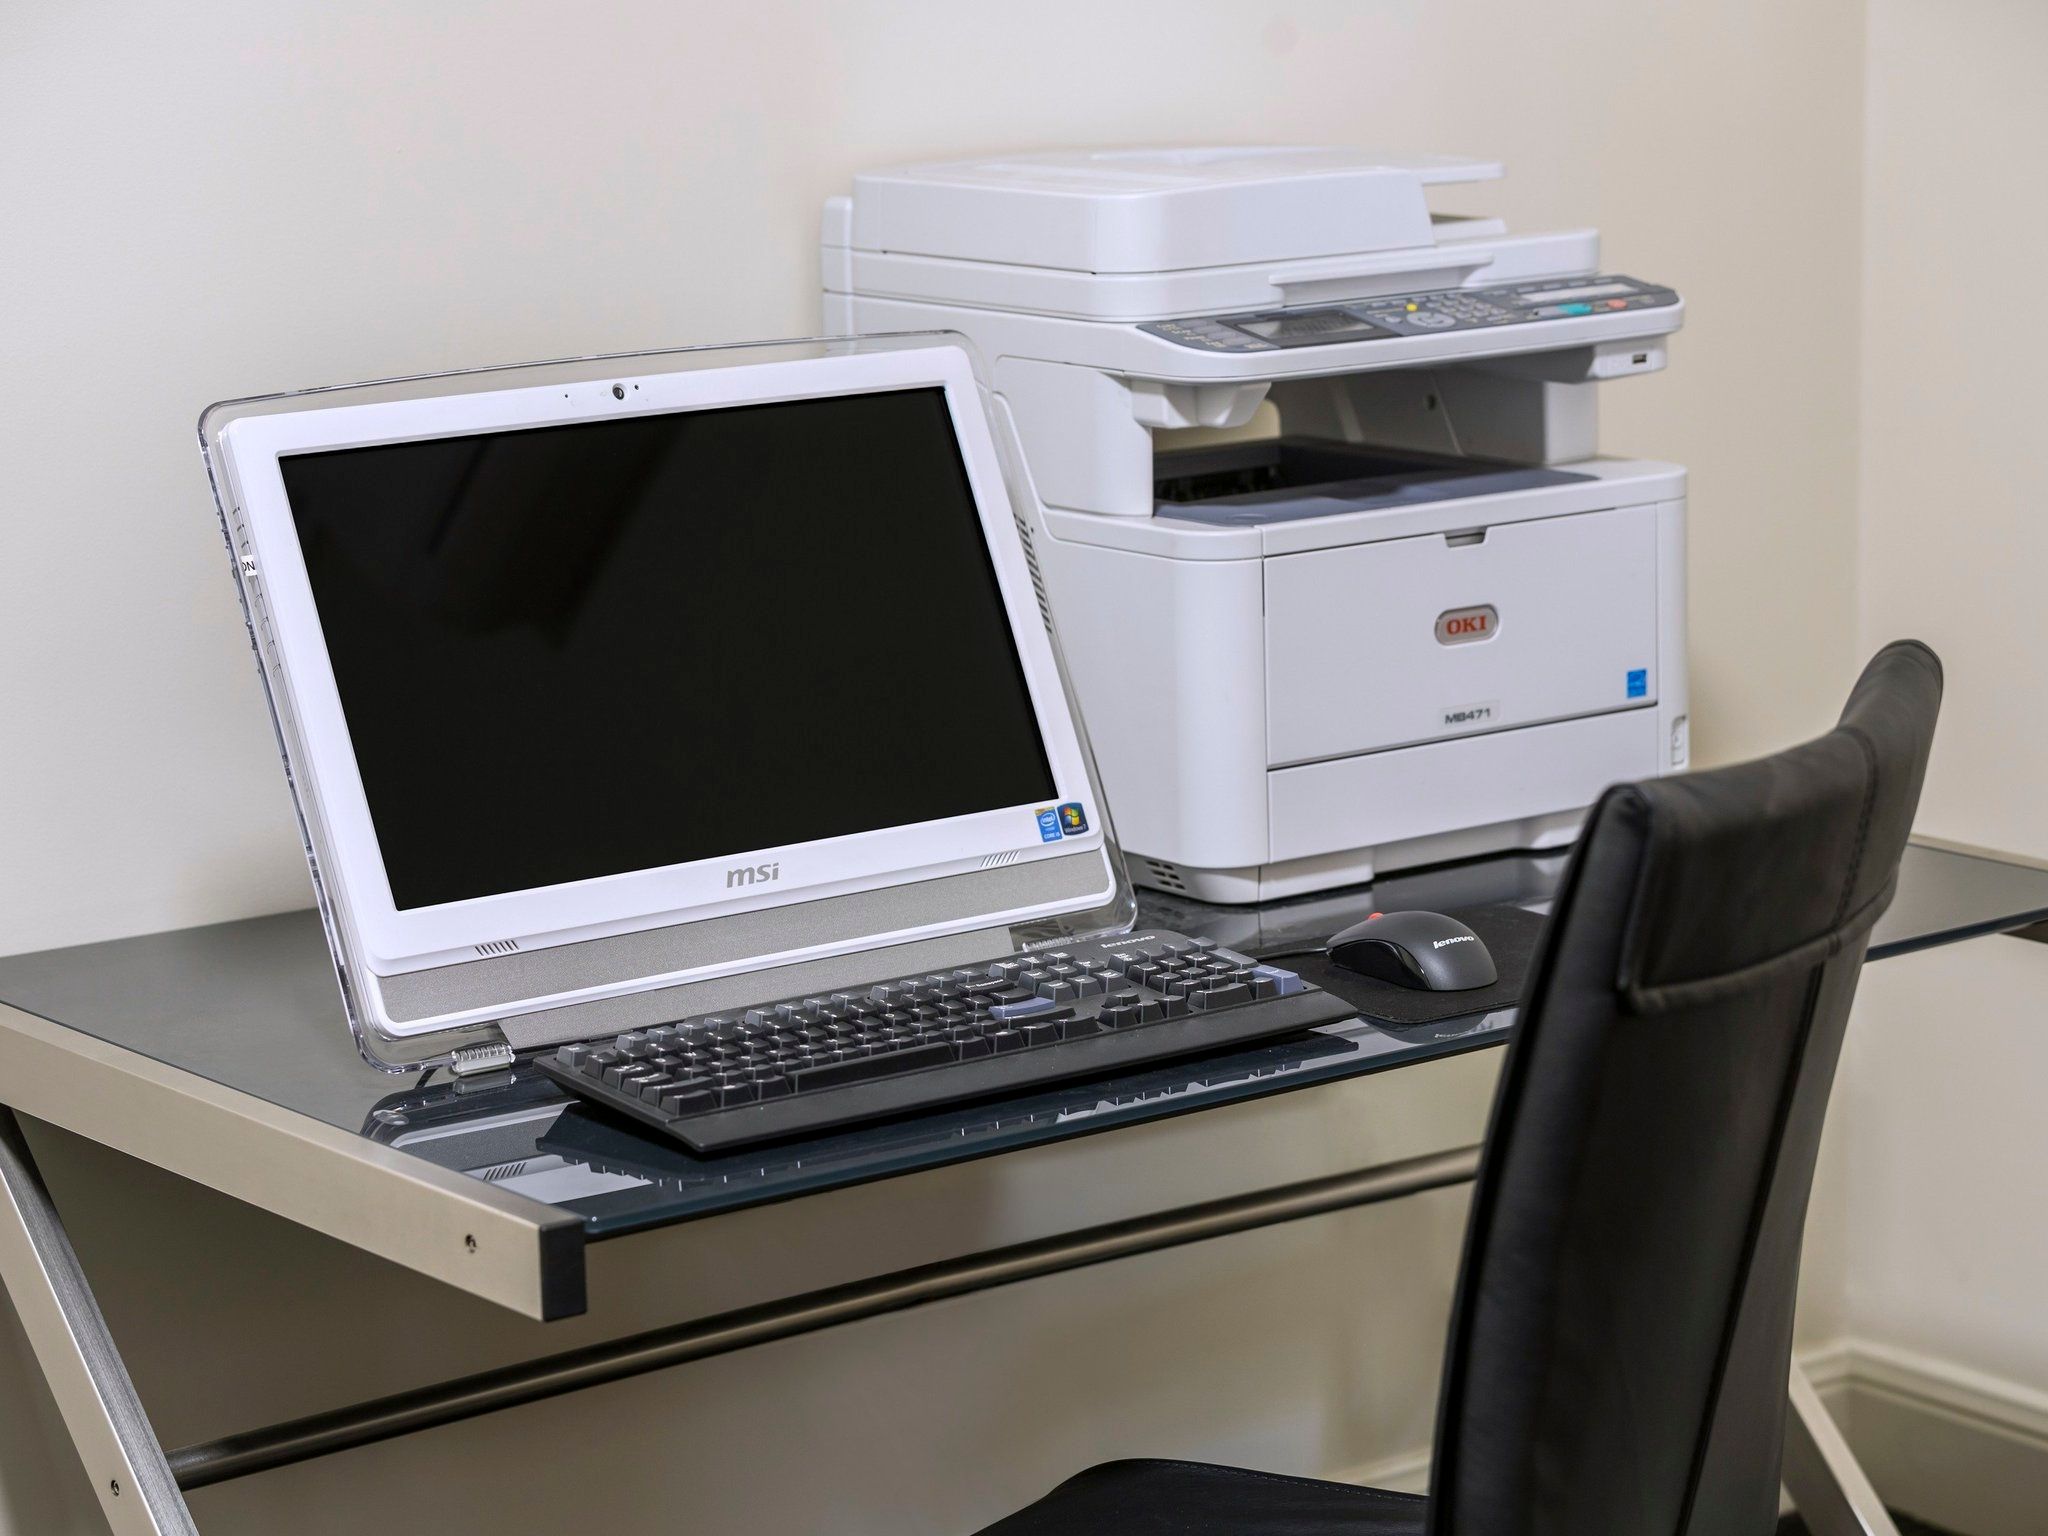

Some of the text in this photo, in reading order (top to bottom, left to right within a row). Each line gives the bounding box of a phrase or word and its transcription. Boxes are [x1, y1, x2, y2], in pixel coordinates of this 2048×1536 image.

[1446, 615, 1487, 635] OKI
[1445, 708, 1491, 724] MB471
[726, 862, 779, 888] msi
[1101, 935, 1156, 948] lenovo
[1433, 936, 1474, 949] lenovo
